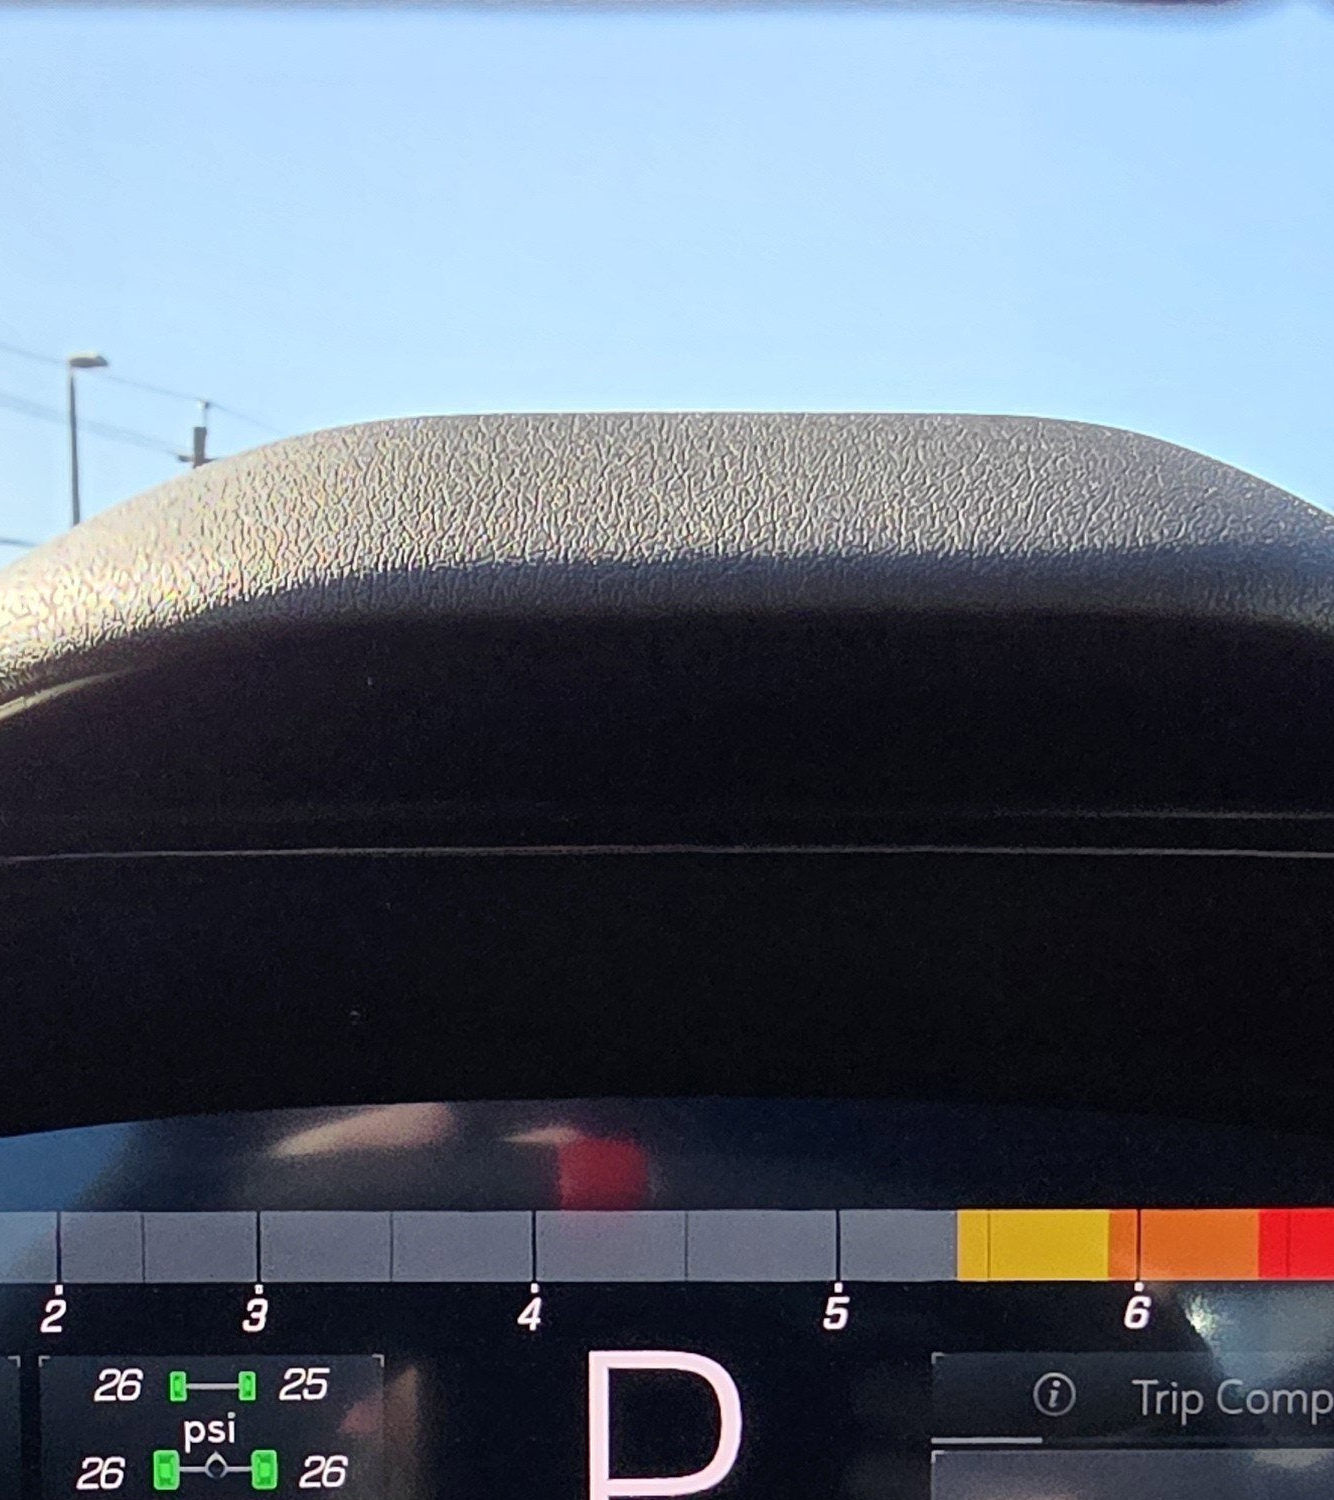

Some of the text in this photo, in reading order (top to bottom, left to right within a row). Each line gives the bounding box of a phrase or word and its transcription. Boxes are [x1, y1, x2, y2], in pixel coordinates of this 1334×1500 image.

[40, 1299, 67, 1333] 2
[242, 1298, 269, 1332] 3
[517, 1296, 542, 1331] 4
[823, 1296, 850, 1330] 5
[1124, 1295, 1152, 1329] 6
[94, 1367, 331, 1402] 26 25
[1131, 1380, 1204, 1426] Trip
[184, 1411, 236, 1454] psi
[76, 1454, 349, 1490] 26 26
